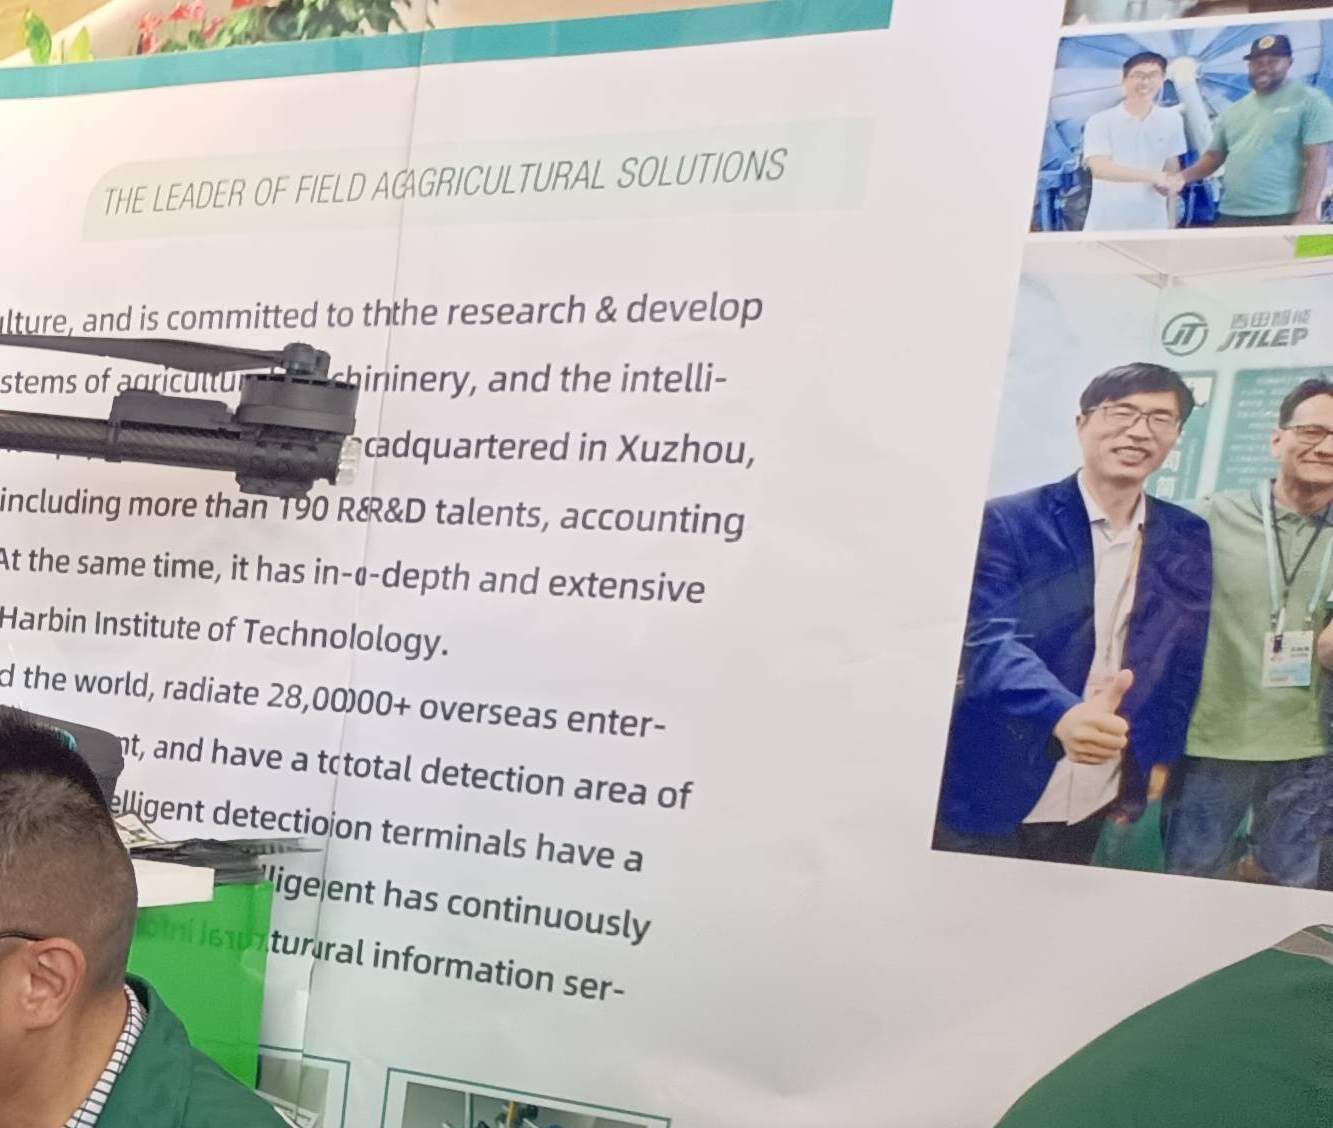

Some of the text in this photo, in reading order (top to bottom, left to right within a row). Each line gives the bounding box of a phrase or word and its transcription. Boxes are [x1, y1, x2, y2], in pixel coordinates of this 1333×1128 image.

[104, 185, 147, 216] THE
[152, 178, 247, 212] LEADER
[253, 174, 290, 206] OF
[295, 171, 366, 204] FIELD
[616, 147, 789, 189] SOLUTIONS
[82, 305, 133, 333] and
[139, 304, 159, 332] is
[166, 300, 319, 330] committed
[327, 302, 354, 328] to
[446, 296, 586, 328] research
[594, 296, 618, 325] &
[626, 291, 764, 331] develop
[1217, 328, 1309, 351] JTILEP
[84, 366, 112, 394] of
[487, 363, 551, 394] and
[559, 363, 611, 394] the
[619, 362, 728, 394] intelli-
[577, 433, 608, 463] in
[615, 433, 757, 470] Xuzhou,
[0, 487, 122, 522] including
[128, 493, 198, 518] more
[204, 492, 268, 520] than
[279, 496, 329, 522] 190
[434, 497, 550, 533] talents,
[560, 503, 746, 544] accounting
[28, 548, 71, 574] the
[76, 554, 147, 578] same
[152, 551, 222, 585] time,
[230, 553, 250, 582] it
[256, 554, 306, 584] has
[478, 565, 541, 595] and
[547, 571, 707, 604] extensive
[94, 610, 201, 642] Institute
[207, 615, 238, 643] of
[22, 663, 68, 692] the
[74, 670, 156, 705] world,
[162, 675, 261, 707] radiate
[418, 696, 558, 731] overseas
[565, 707, 668, 740] enter-
[152, 736, 205, 763] and
[210, 738, 284, 770] have
[290, 751, 310, 773] a
[419, 756, 567, 799] detection
[573, 772, 648, 807] area
[656, 780, 695, 811] of
[111, 789, 206, 826] elligent
[380, 818, 528, 862] terminals
[534, 833, 616, 870] have
[623, 847, 645, 873] a
[383, 879, 439, 913] has
[446, 888, 653, 946] continuously
[372, 940, 556, 994] information
[562, 970, 627, 1003] ser-
